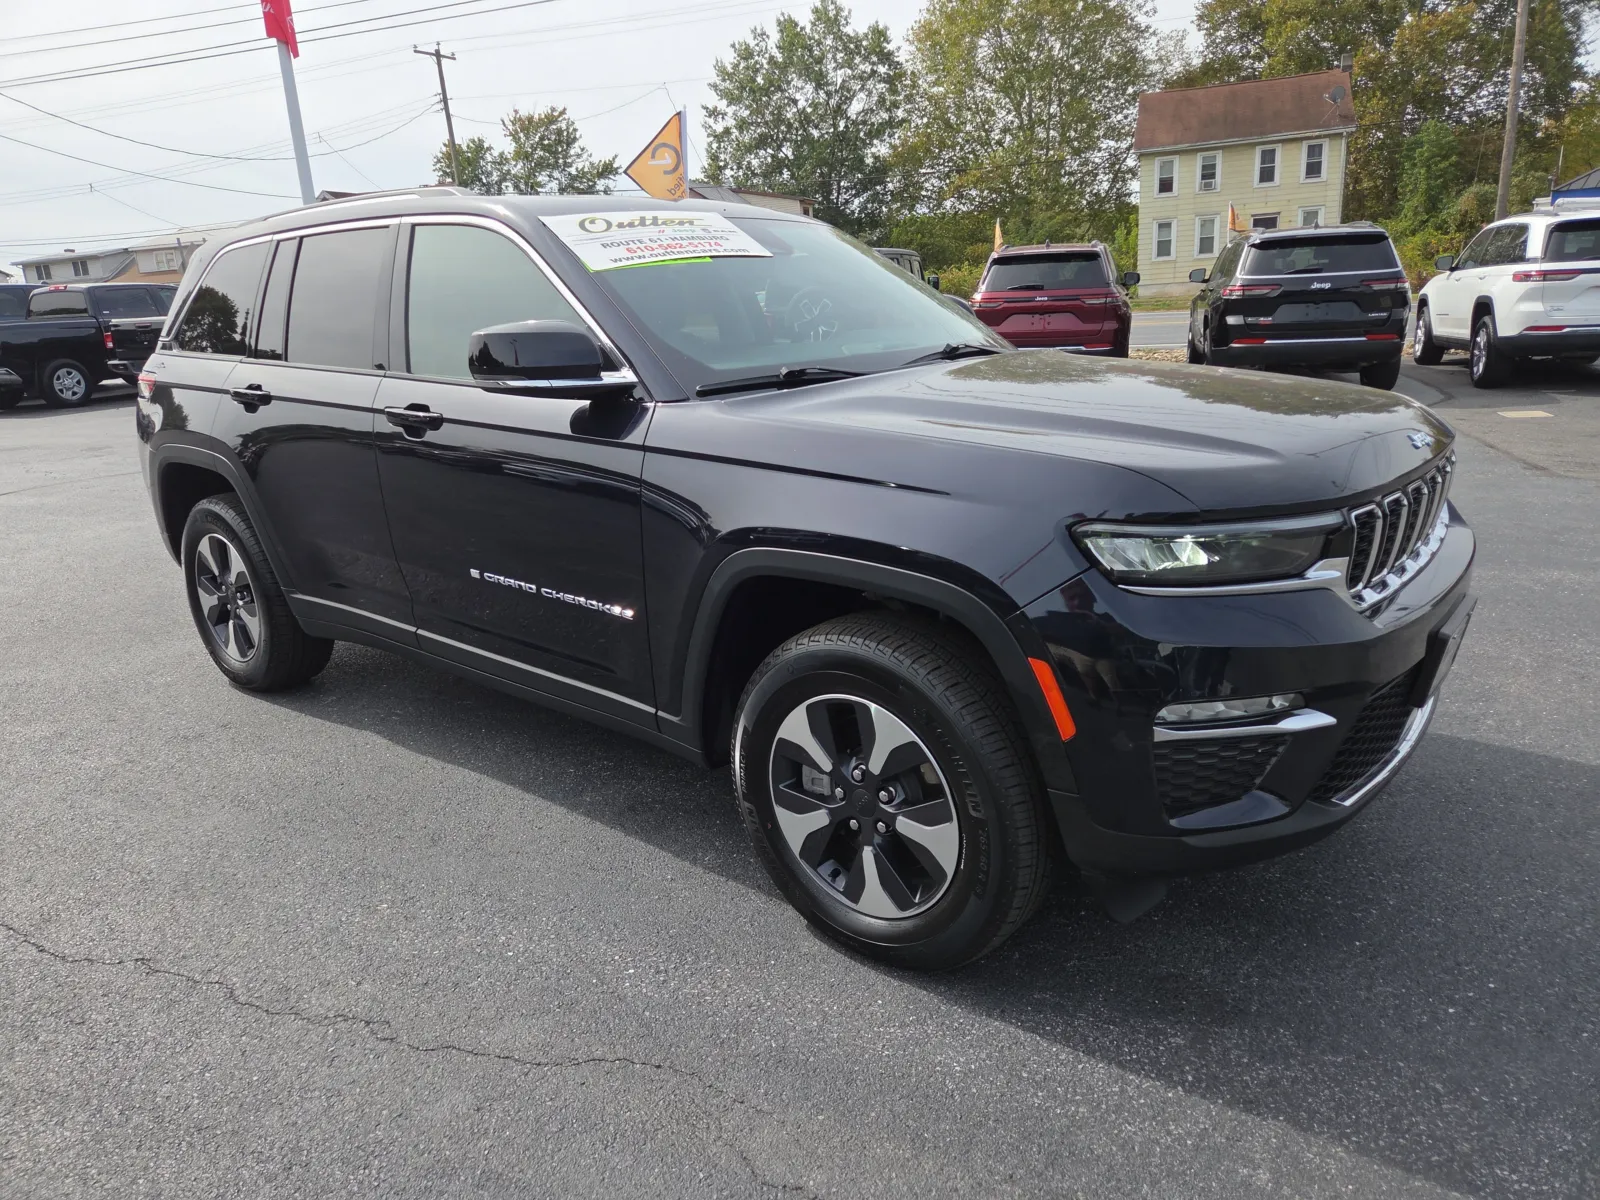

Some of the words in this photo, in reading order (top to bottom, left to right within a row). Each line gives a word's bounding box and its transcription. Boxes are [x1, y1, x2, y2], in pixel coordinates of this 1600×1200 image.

[578, 215, 711, 233] Outten
[600, 238, 645, 249] ROUTE
[625, 241, 723, 254] 610-562-5174
[610, 247, 750, 263] www.outtencars.com
[1310, 281, 1331, 290] Jeep
[483, 572, 537, 593] GRAND
[541, 588, 634, 620] CHEROKEE
